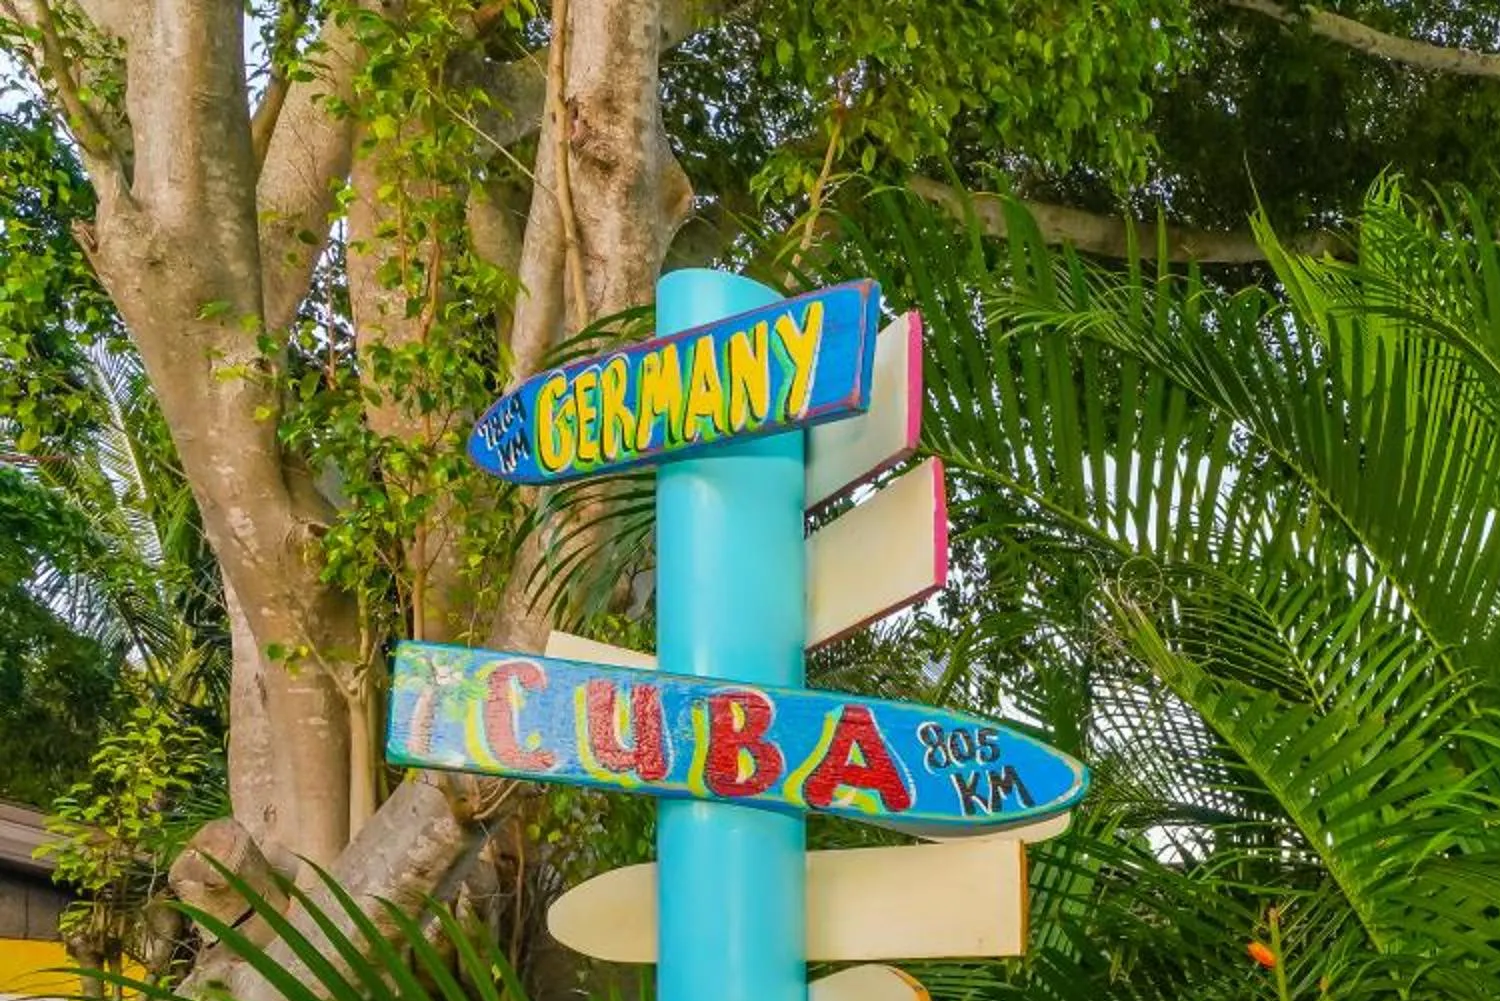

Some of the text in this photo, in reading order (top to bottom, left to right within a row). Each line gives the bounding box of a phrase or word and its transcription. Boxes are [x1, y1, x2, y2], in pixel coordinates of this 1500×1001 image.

[537, 301, 824, 473] GERMANY
[482, 659, 916, 812] CUBA
[917, 722, 1001, 775] 805
[951, 764, 1036, 817] KM
